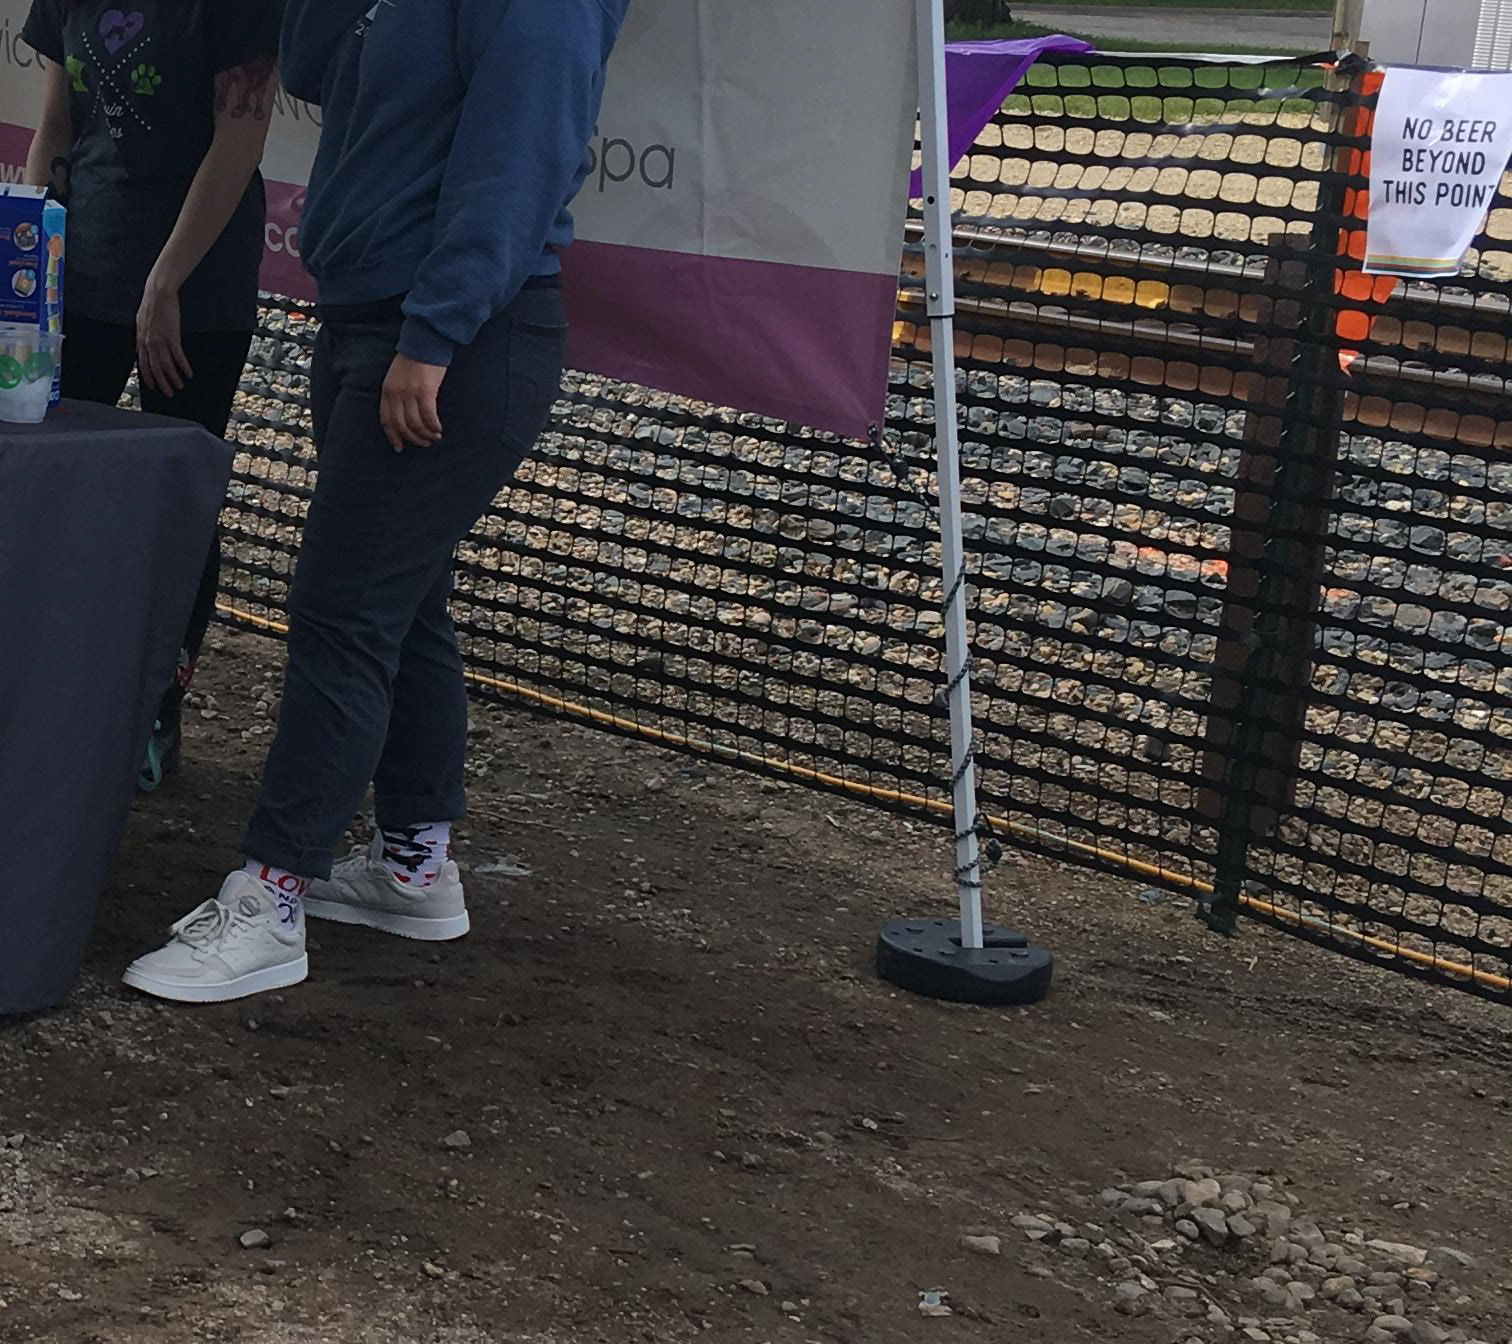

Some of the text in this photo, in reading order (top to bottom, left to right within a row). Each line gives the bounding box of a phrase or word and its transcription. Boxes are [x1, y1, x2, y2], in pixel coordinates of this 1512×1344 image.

[1402, 117, 1498, 144] NO BEER
[1401, 148, 1486, 176] BEYOND
[1383, 179, 1427, 206] THIS
